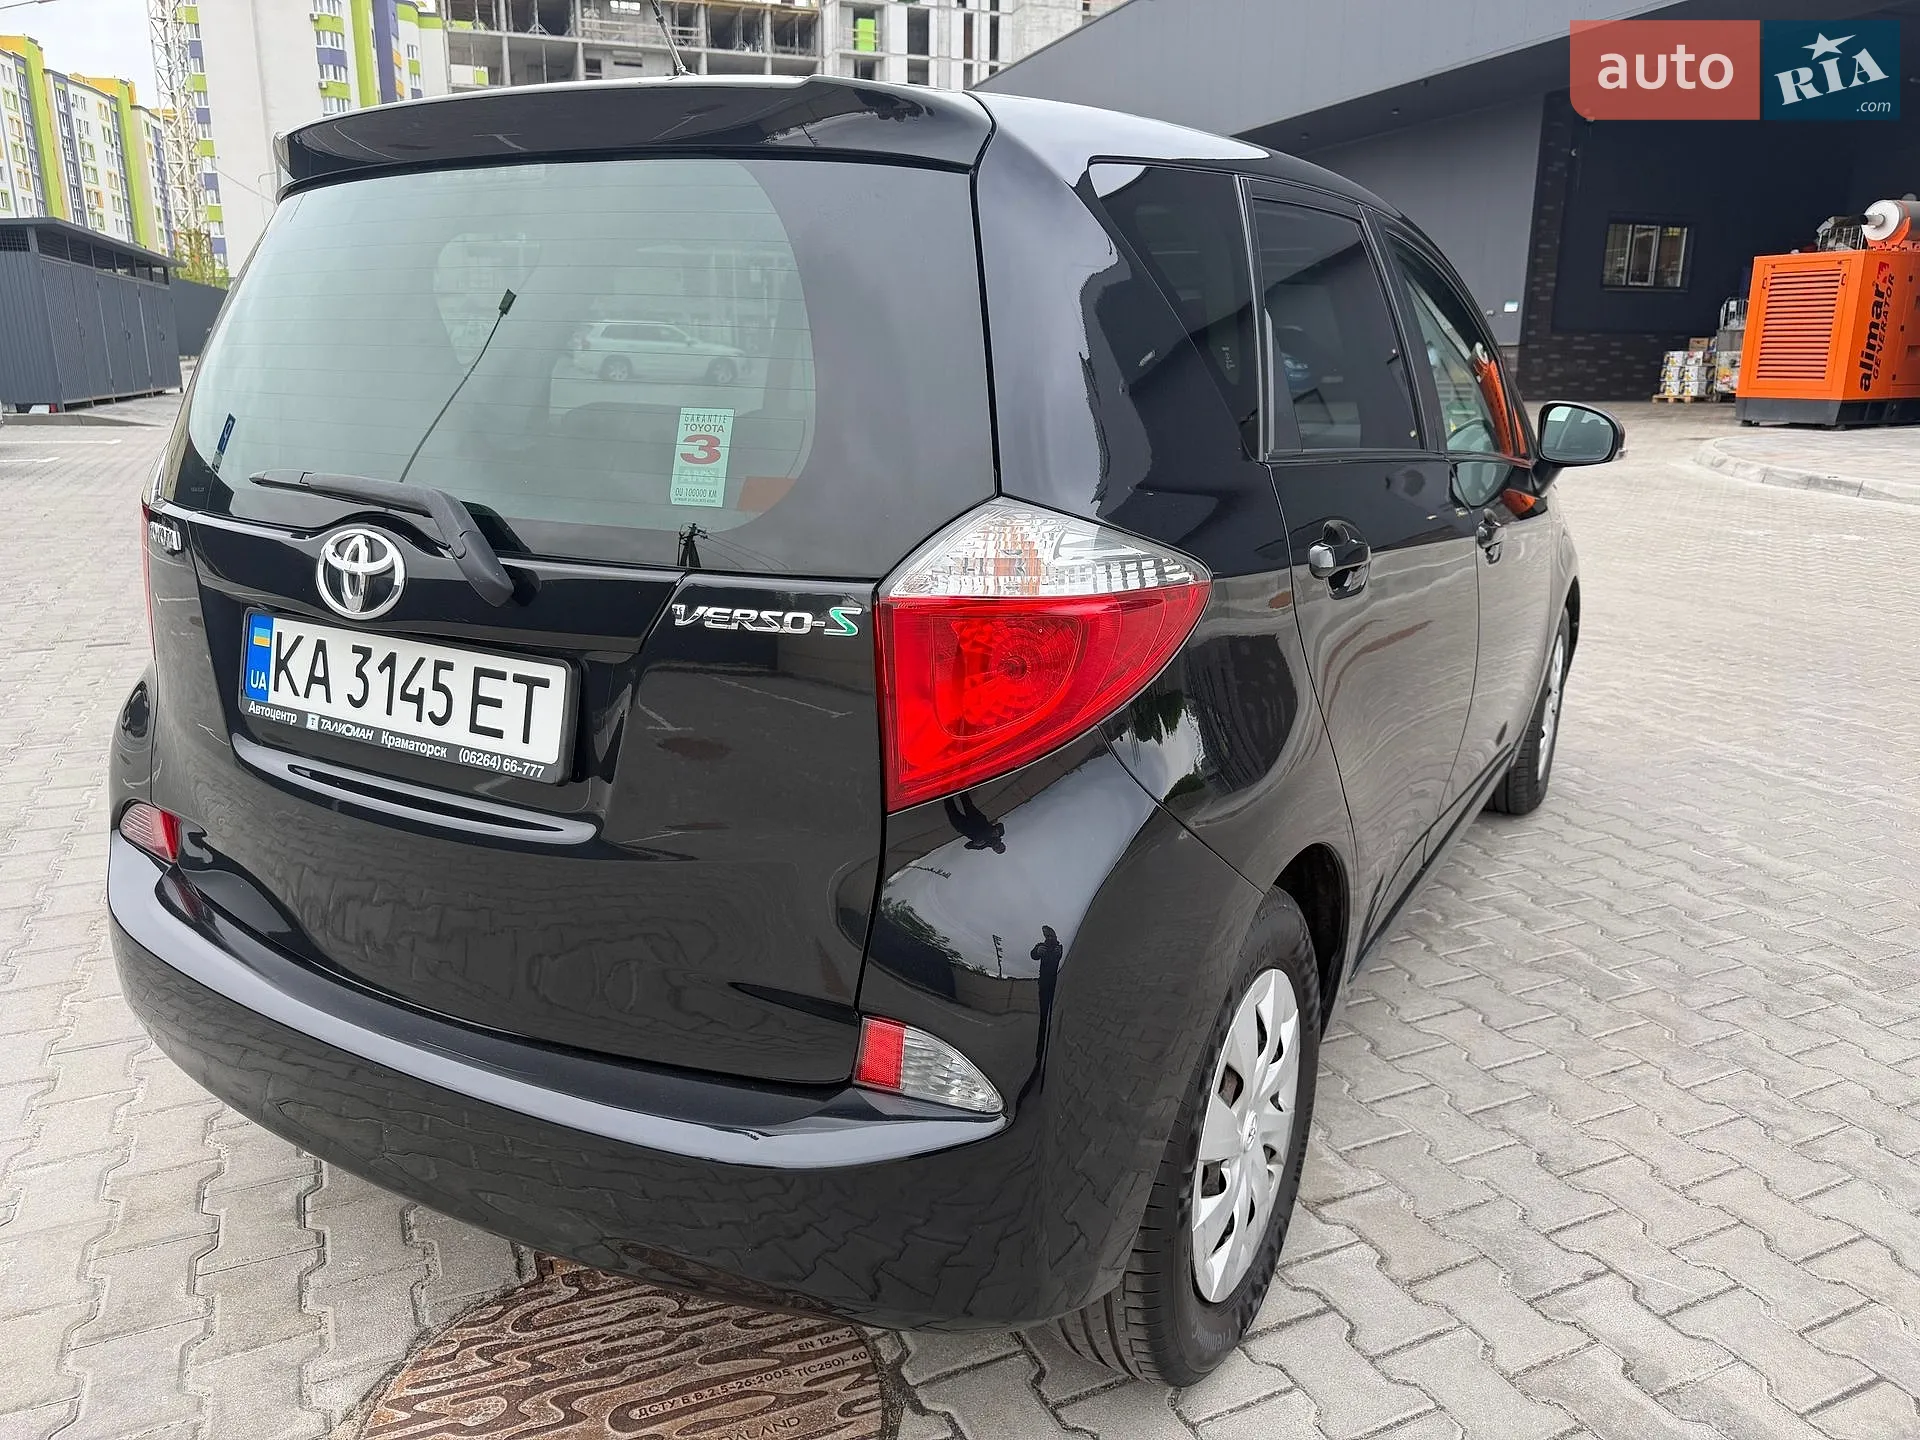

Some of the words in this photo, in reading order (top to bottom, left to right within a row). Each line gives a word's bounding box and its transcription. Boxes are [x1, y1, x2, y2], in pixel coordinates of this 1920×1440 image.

[1859, 283, 1886, 392] alimar
[1872, 273, 1895, 380] GENERATOR
[684, 413, 728, 424] GARANTIE
[684, 423, 725, 433] TOYOTA
[679, 434, 722, 465] 3
[671, 603, 863, 637] VERSO-S
[250, 669, 268, 691] UA
[273, 631, 332, 704] KA
[346, 644, 456, 727] 3145
[468, 666, 551, 745] ET
[248, 701, 297, 726] Автоцентр
[320, 718, 374, 741] ТАЛИСМАН
[381, 730, 448, 759] Краматорск
[458, 747, 502, 771] (06264)
[502, 760, 546, 778] 66-777
[797, 1340, 815, 1350] EN
[817, 1330, 854, 1346] 124-2
[638, 1400, 675, 1418] ДСТУ
